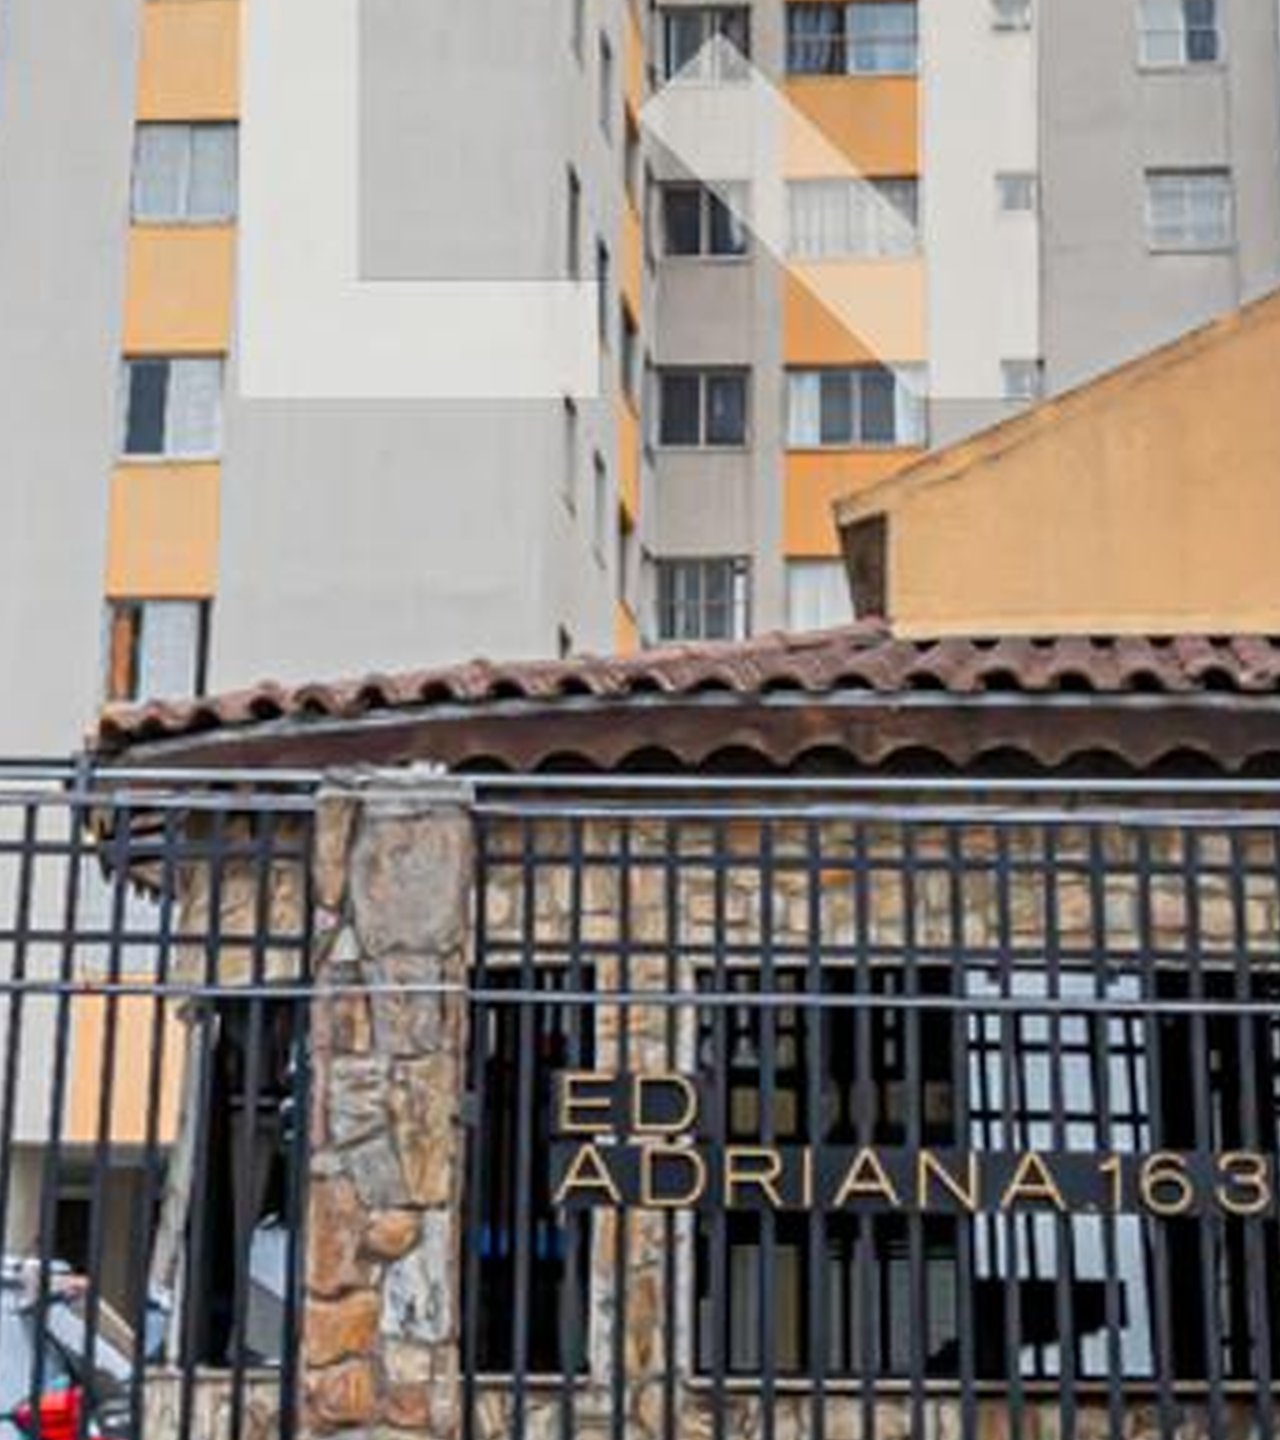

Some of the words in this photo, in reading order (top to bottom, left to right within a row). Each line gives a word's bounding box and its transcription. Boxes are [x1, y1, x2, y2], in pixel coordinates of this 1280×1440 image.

[559, 1072, 698, 1134] ED
[553, 1144, 1066, 1212] ADRIANA
[1098, 1150, 1273, 1216] 163
